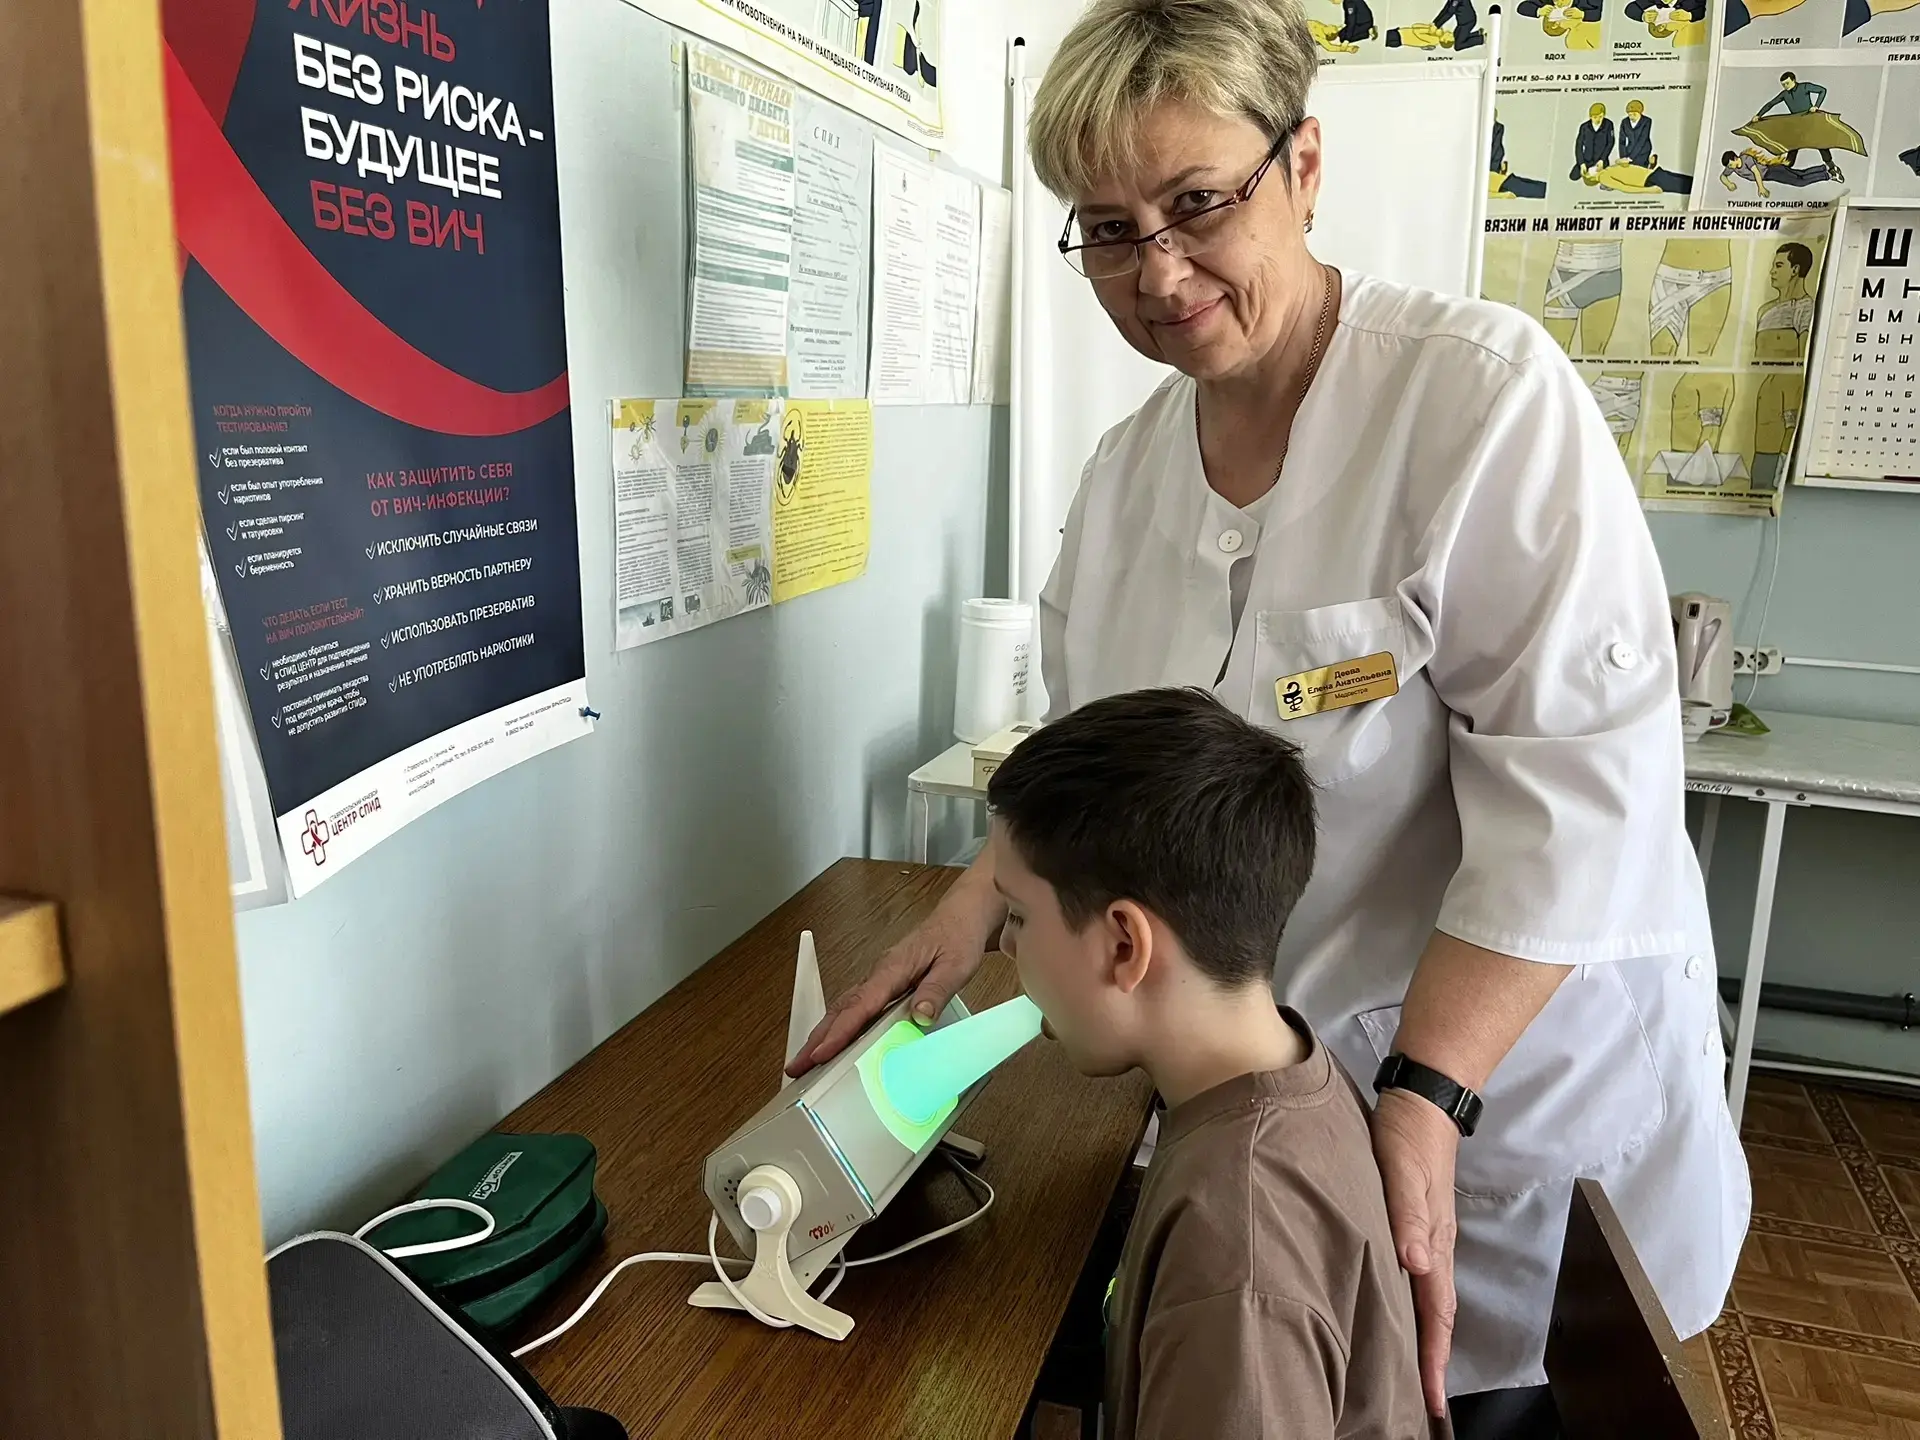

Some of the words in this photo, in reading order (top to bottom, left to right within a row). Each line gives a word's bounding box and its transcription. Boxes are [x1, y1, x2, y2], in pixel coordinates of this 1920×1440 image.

[737, 0, 785, 36] КРОВОТЕЧЕНИЯ
[788, 27, 796, 41] НА
[798, 33, 813, 50] РАНУ
[815, 43, 861, 77] НАКЛАДЫВАЕТСЯ
[862, 69, 894, 92] СТЕРИЛЬНАЯ
[1613, 42, 1642, 50] ВЫДОХ
[1544, 53, 1566, 61] ВДОХ
[293, 33, 384, 106] БЕЗ
[1582, 73, 1605, 81] ОДНУ
[300, 105, 502, 200] БУДУЩЕЕ
[1727, 200, 1762, 208] ТУШЕНИЕ
[1765, 200, 1804, 208] ГОРЯЩЕЙ
[310, 180, 395, 240] БЕЗ
[406, 200, 485, 254] ВИЧ
[1532, 218, 1549, 232] НА
[1555, 217, 1604, 231] ЖИВОТ
[1609, 217, 1620, 231] И
[1625, 216, 1686, 231] ВЕРХНИЕ
[1692, 216, 1781, 231] КОНЕЧНОСТИ
[1866, 228, 1913, 267] Ш
[1861, 278, 1885, 298] М
[1902, 278, 1920, 299] Н
[1858, 308, 1874, 322] Ы
[1887, 309, 1903, 323] М
[1856, 333, 1867, 343] Б
[1878, 333, 1890, 344] Ы
[1900, 334, 1913, 344] Н
[1852, 353, 1863, 362] И
[1875, 354, 1885, 363] Н
[1898, 355, 1909, 364] Ш
[1849, 372, 1858, 380] Н
[1887, 373, 1896, 381] Ы
[1906, 374, 1915, 382] И
[1884, 390, 1893, 398] Н
[213, 405, 243, 417] КОГДА
[244, 404, 276, 417] НУЖНО
[278, 404, 312, 417] ПРОЙТИ
[216, 421, 288, 433] ТЕСТИРОВАНИЕ?
[222, 447, 239, 456] если
[240, 444, 254, 455] был
[254, 444, 283, 455] половой
[283, 444, 308, 453] контакт
[224, 457, 238, 468] без
[239, 457, 285, 469] презерватива
[230, 483, 247, 492] если
[247, 480, 262, 490] был
[262, 480, 278, 489] опыт
[279, 476, 324, 490] употребления
[366, 471, 396, 490] КАК
[400, 465, 476, 487] ЗАЩИТИТЬ
[479, 462, 513, 479] СЕБЯ
[233, 493, 272, 505] наркотиков
[371, 499, 389, 517] ОТ
[393, 486, 510, 515] ВИЧ-ИНФЕКЦИИ?
[239, 520, 256, 528] если
[255, 516, 278, 526] сделан
[279, 512, 304, 524] пирсинг
[247, 527, 284, 540] татуировки
[377, 532, 441, 557] ИСКЛЮЧИТЬ
[442, 523, 505, 544] СЛУЧАЙНЫЕ
[505, 518, 538, 534] СВЯЗИ
[247, 554, 263, 563] если
[263, 547, 302, 561] планируется
[249, 560, 295, 575] беременность
[383, 579, 430, 601] ХРАНИТЬ
[430, 568, 482, 590] ВЕРНОСТЬ
[483, 557, 533, 578] ПАРТНЕРУ
[261, 615, 278, 628] ЧТО
[310, 603, 331, 616] ЕСЛИ
[331, 597, 348, 610] ТЕСТ
[391, 611, 469, 645] ИСПОЛЬЗОВАТЬ
[469, 595, 535, 622] ПРЕЗЕРВАТИВ
[265, 632, 278, 644] НА
[278, 627, 295, 640] ВИЧ
[272, 650, 308, 668] необходимо
[308, 640, 339, 656] обратиться
[279, 664, 298, 678] СПИД
[297, 657, 317, 672] ЦЕНТР
[317, 656, 328, 666] для
[328, 641, 371, 661] подтверждения
[398, 671, 411, 688] НЕ
[413, 650, 479, 683] УПОТРЕБЛЯТЬ
[479, 632, 535, 660] НАРКОТИКИ
[277, 674, 309, 693] результата
[313, 661, 345, 678] назначения
[345, 653, 368, 666] лечения
[1334, 667, 1361, 680] Деева
[1307, 684, 1334, 695] Елена
[1335, 669, 1392, 688] Анатольевна
[282, 696, 312, 714] постоянно
[312, 685, 343, 702] принимать
[342, 674, 370, 690] лекарства
[1335, 687, 1368, 700] Медсестра
[285, 714, 297, 725] под
[297, 702, 327, 720] контролем
[343, 688, 360, 700] чтобы
[288, 727, 296, 736] не
[296, 716, 324, 734] допустить
[324, 705, 348, 722] развития
[331, 811, 357, 836] ЦЕНТР
[359, 797, 381, 818] СПИД
